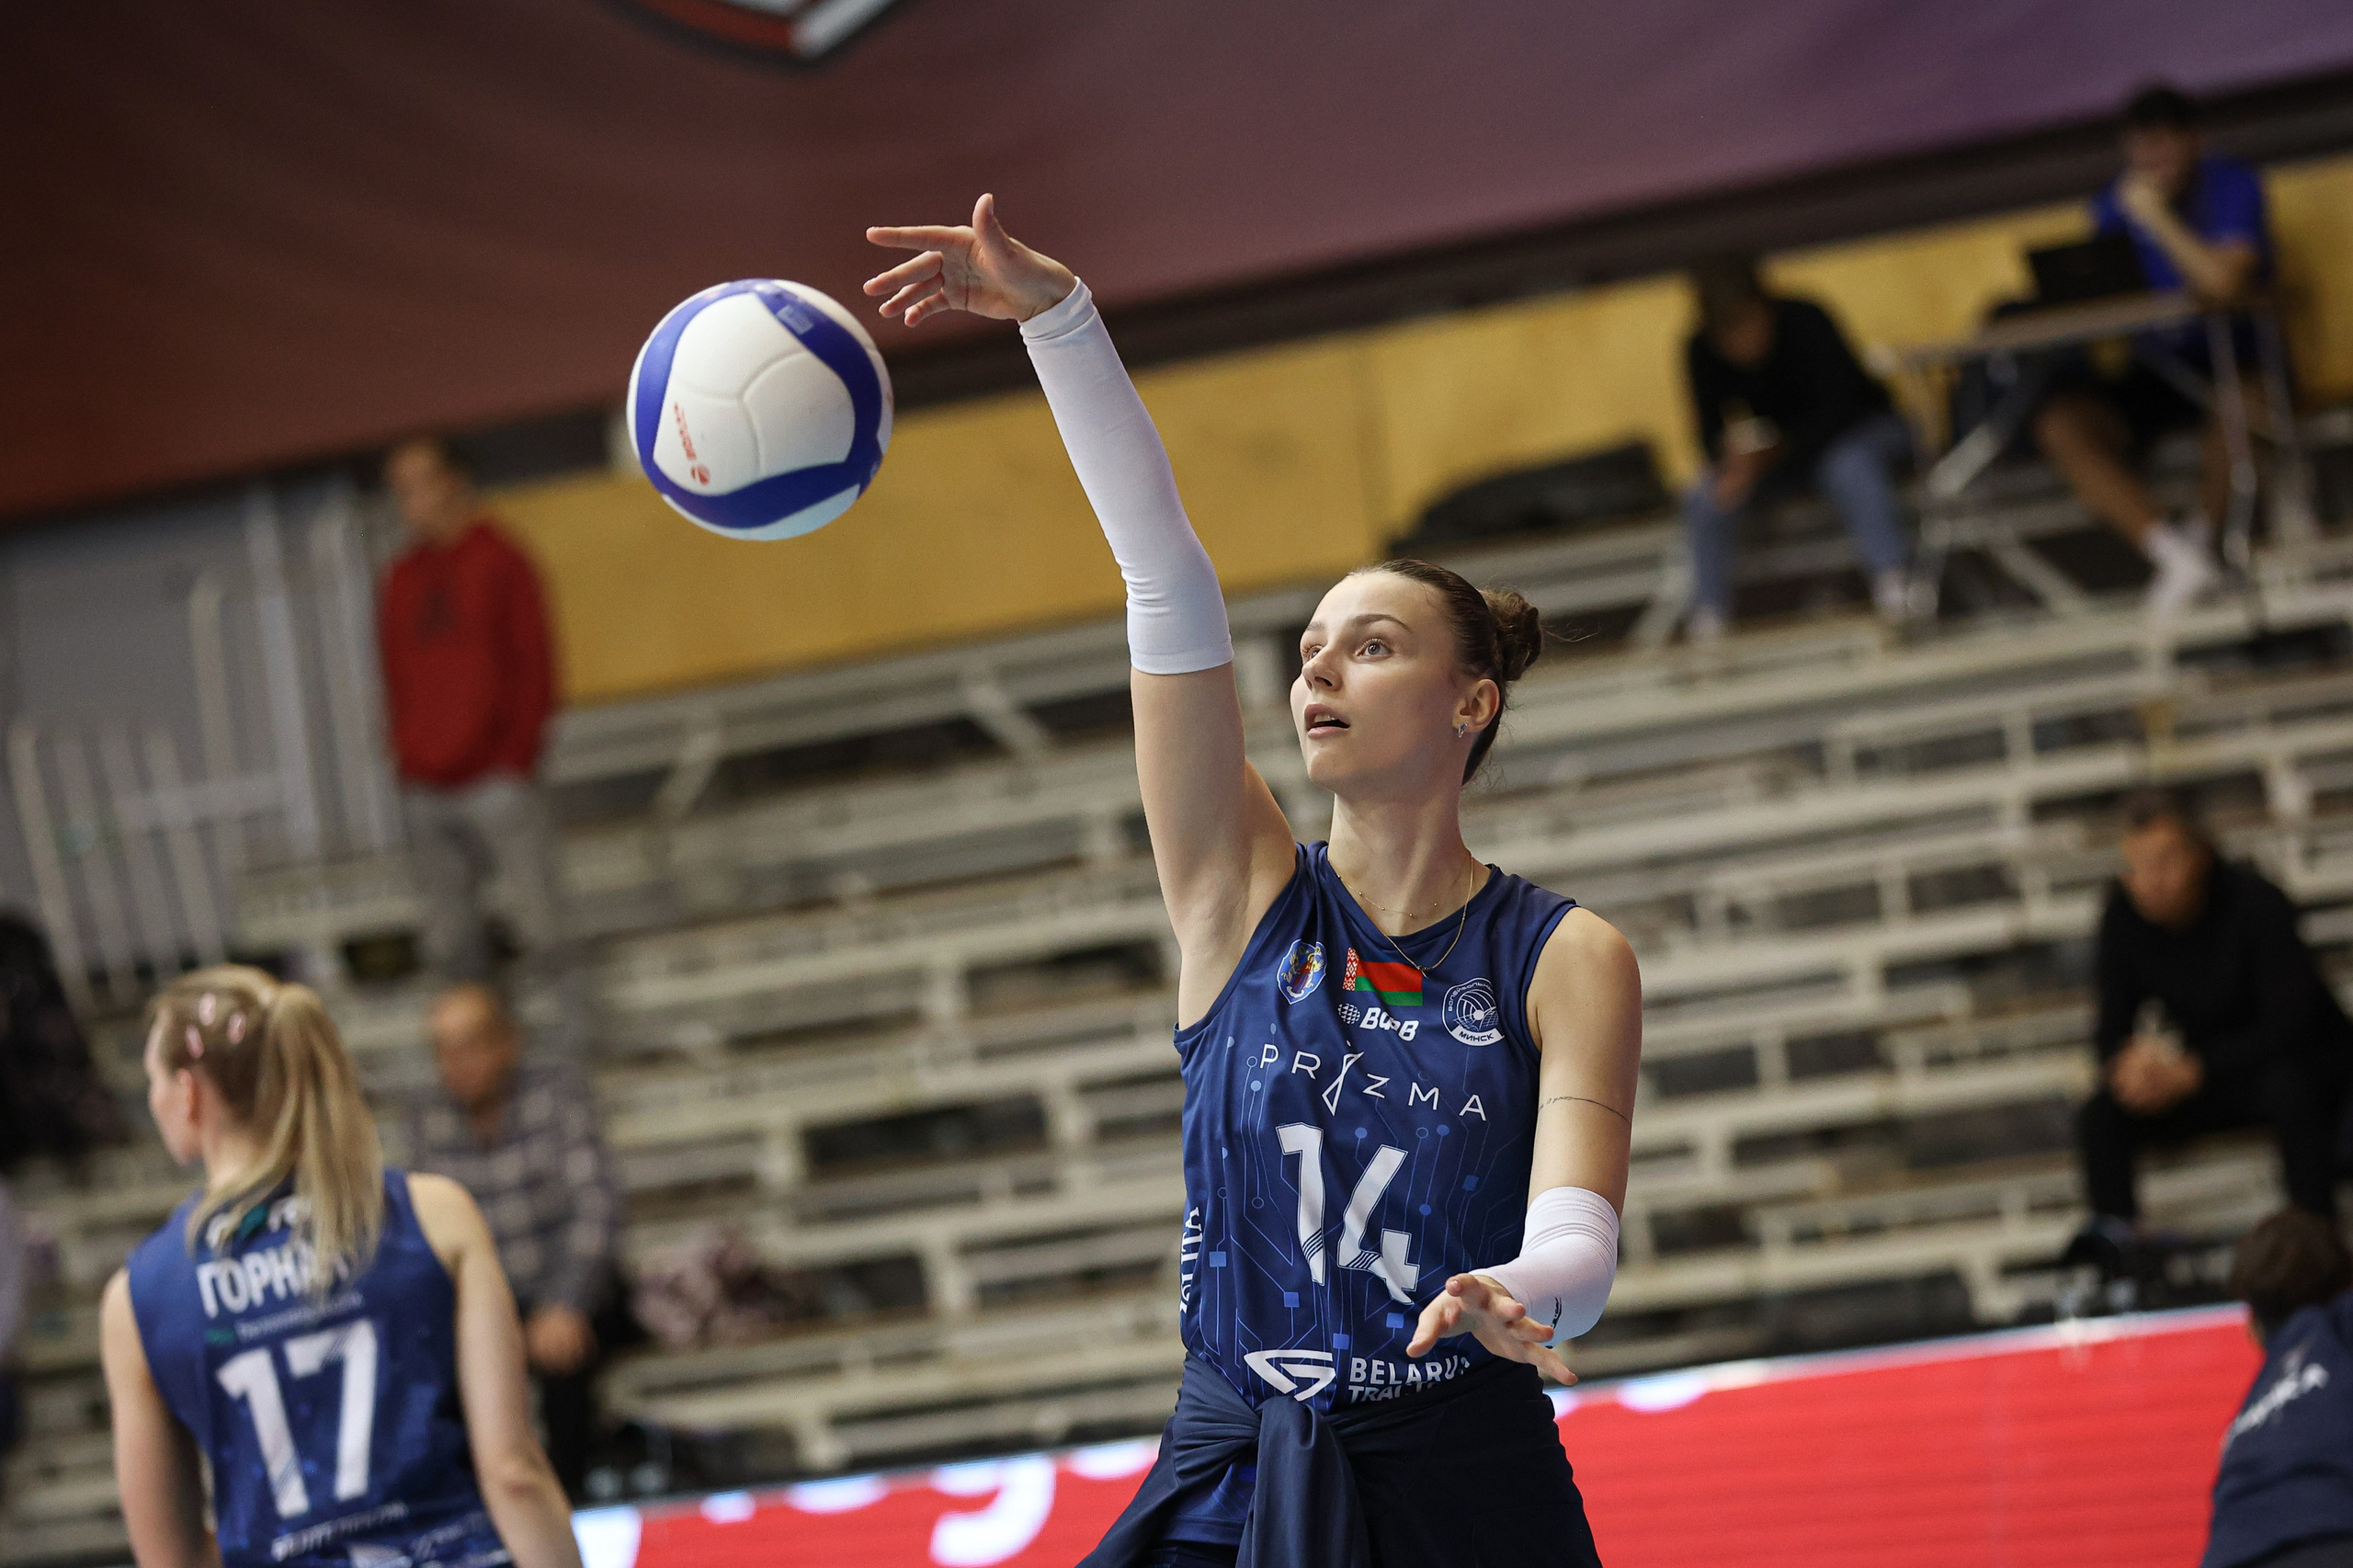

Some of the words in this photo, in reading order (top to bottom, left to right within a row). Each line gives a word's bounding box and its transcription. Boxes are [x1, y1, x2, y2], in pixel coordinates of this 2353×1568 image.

[1259, 1040, 1487, 1121] PRIZMA
[1459, 1030, 1495, 1042] МИНСК
[1275, 1121, 1420, 1305] 14
[215, 1318, 379, 1520] 17
